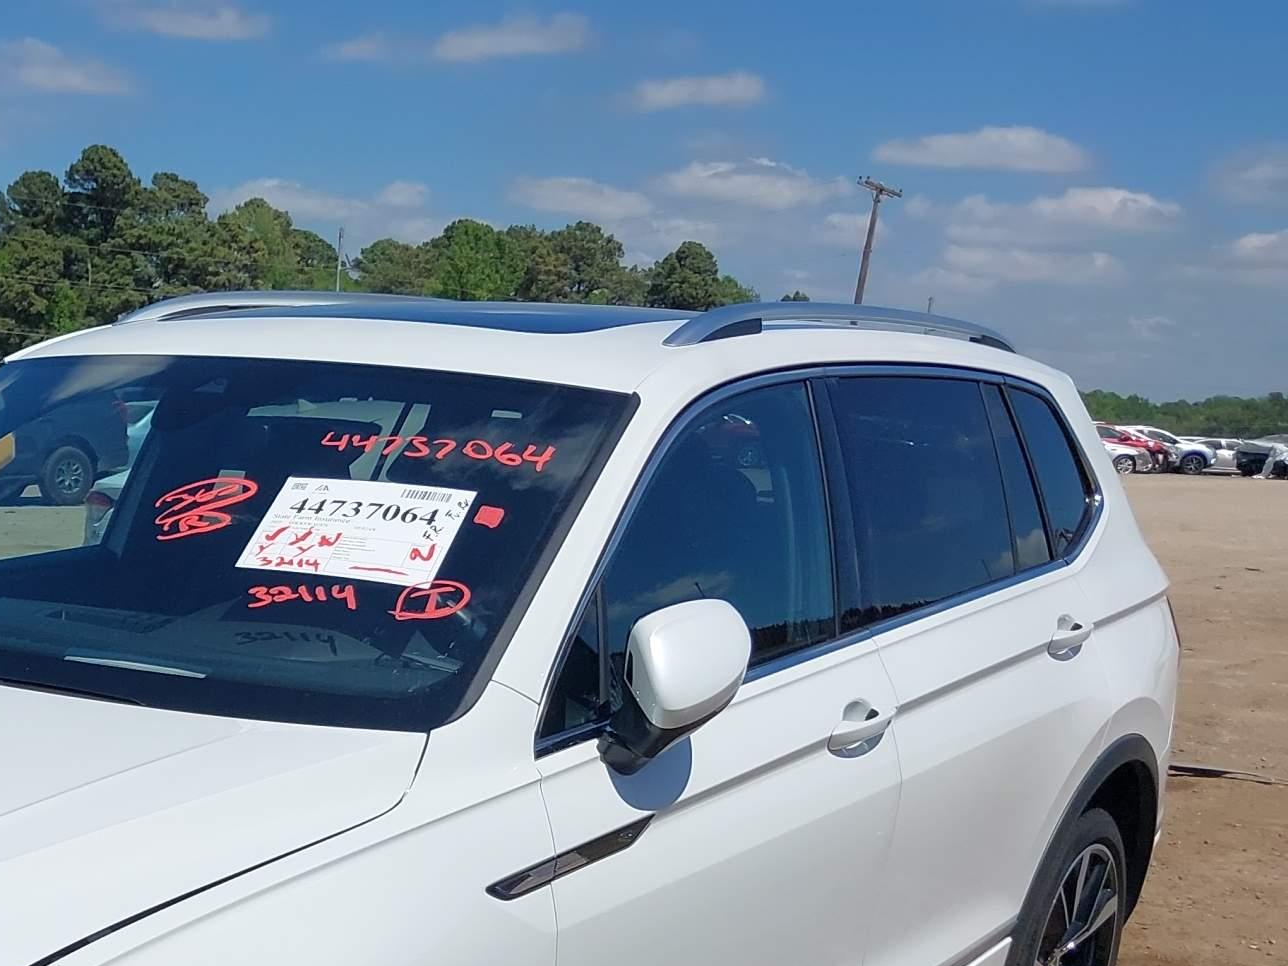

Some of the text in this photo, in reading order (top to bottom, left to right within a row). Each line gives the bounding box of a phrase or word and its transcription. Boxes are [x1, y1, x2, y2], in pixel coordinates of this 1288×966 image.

[289, 497, 440, 526] 44737064
[293, 513, 312, 521] Farm
[314, 515, 351, 525] Insurance
[247, 584, 357, 610] 32114
